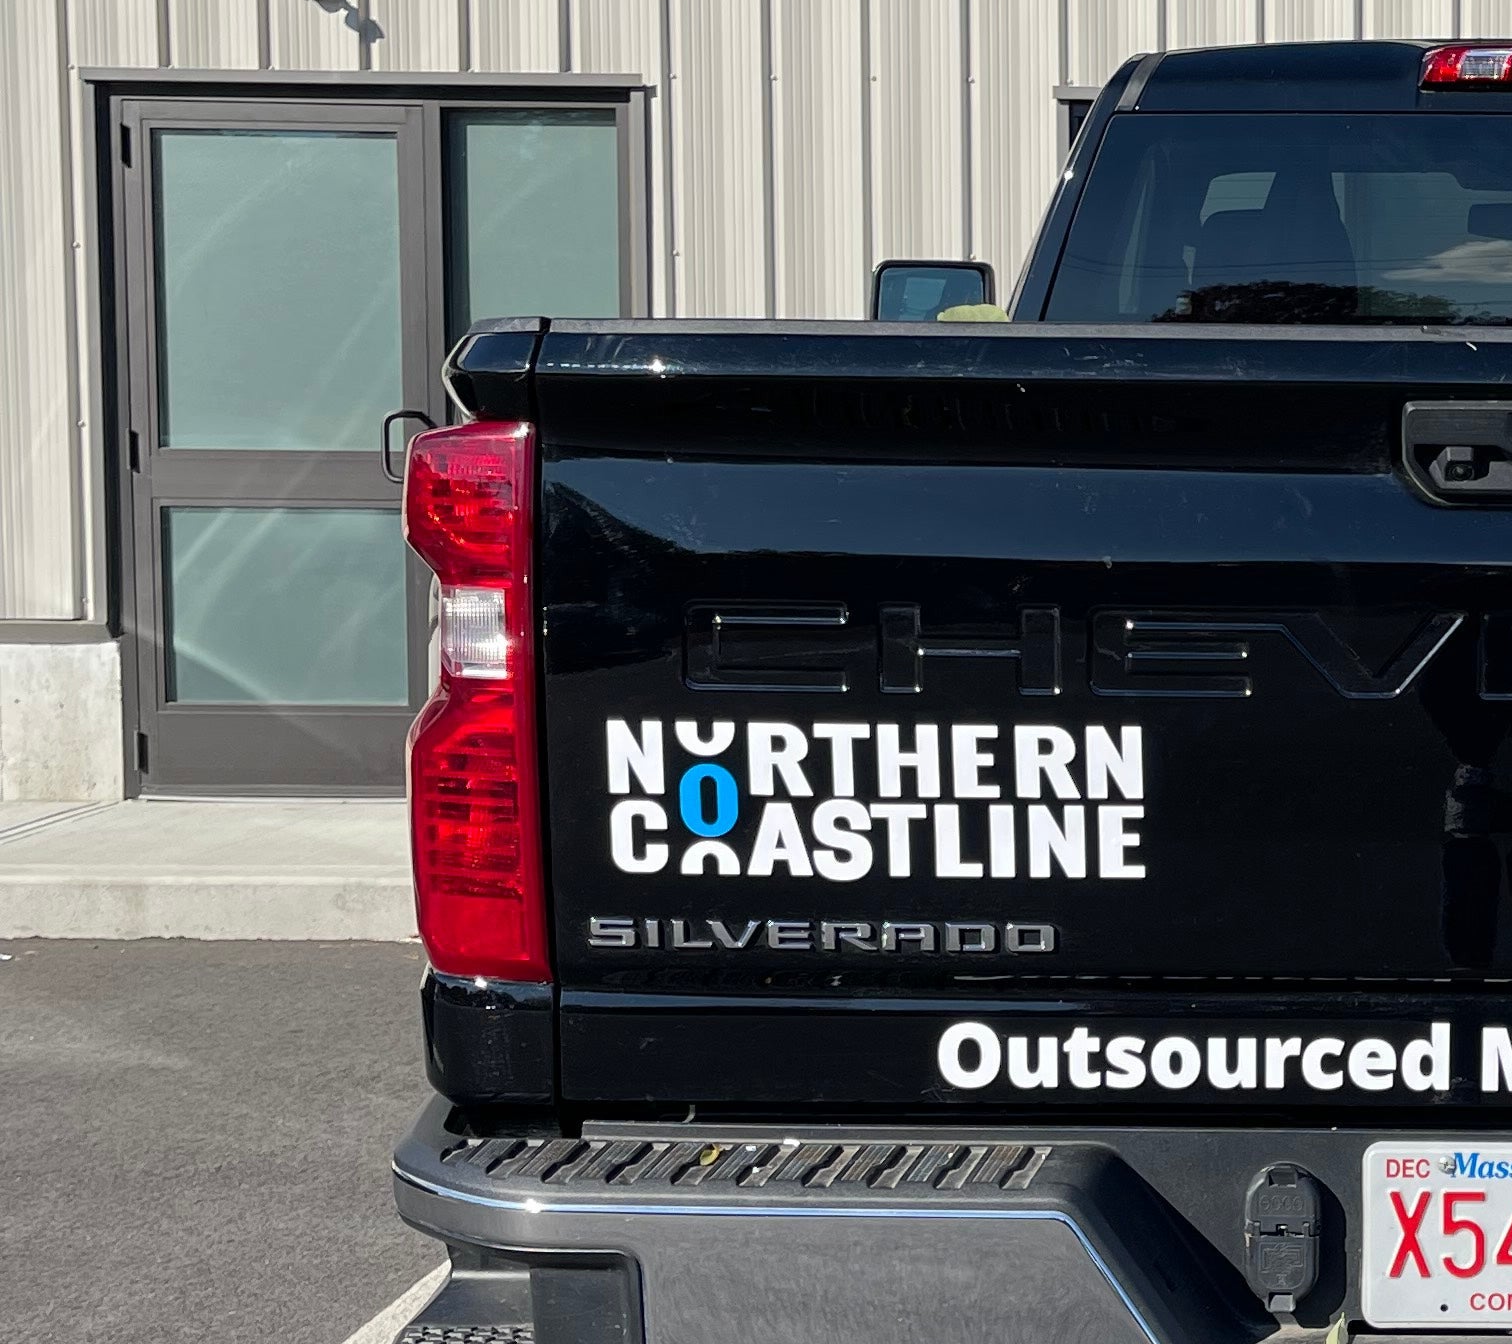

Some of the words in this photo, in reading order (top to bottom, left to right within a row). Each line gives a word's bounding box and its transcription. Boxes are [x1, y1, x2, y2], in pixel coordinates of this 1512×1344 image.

[605, 718, 1146, 800] NORTHERN
[608, 798, 1147, 882] COASTLINE
[587, 917, 1057, 954] SILVERADO
[937, 1022, 1450, 1091] Outsourced
[1386, 1158, 1431, 1179] DEC
